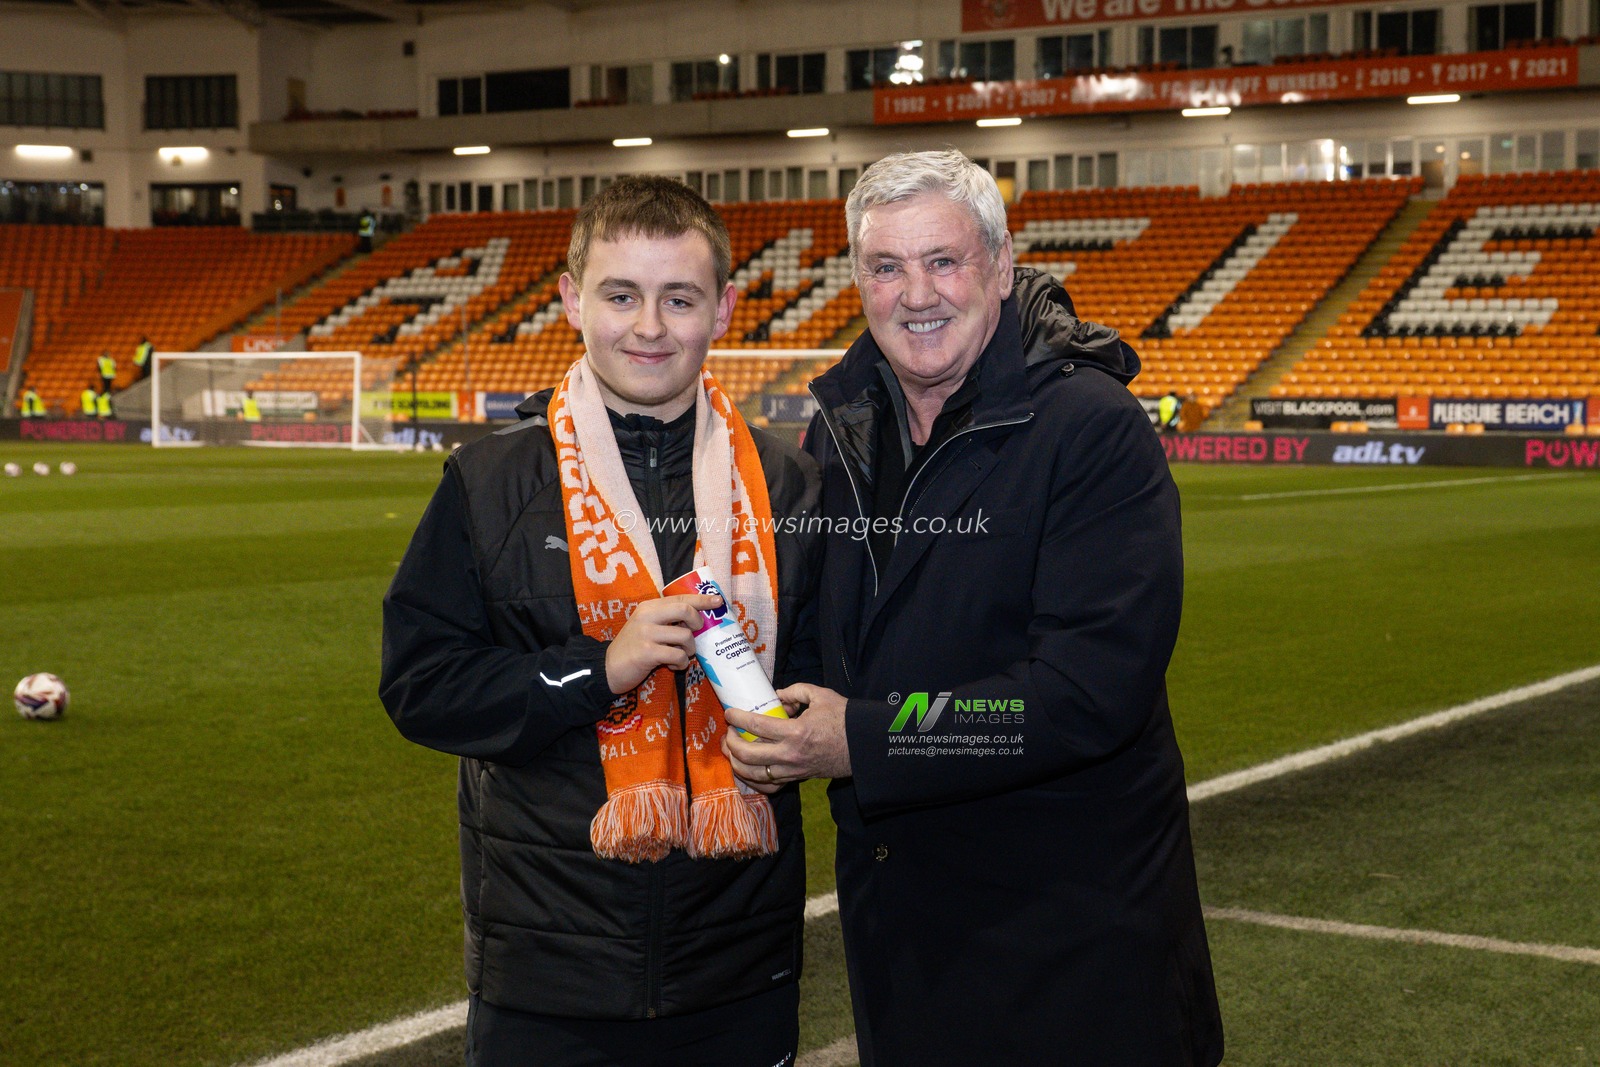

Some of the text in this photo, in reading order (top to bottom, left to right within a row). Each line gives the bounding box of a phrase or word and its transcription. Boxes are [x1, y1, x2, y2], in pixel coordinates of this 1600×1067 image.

[1042, 0, 1096, 21] We
[1103, 0, 1160, 17] are
[1266, 72, 1338, 93] WINNERS
[1447, 63, 1489, 82] 2017
[1525, 58, 1568, 77] 2021
[1505, 404, 1569, 424] BEACH
[1273, 437, 1310, 461] BY
[1332, 441, 1425, 464] adi.tv
